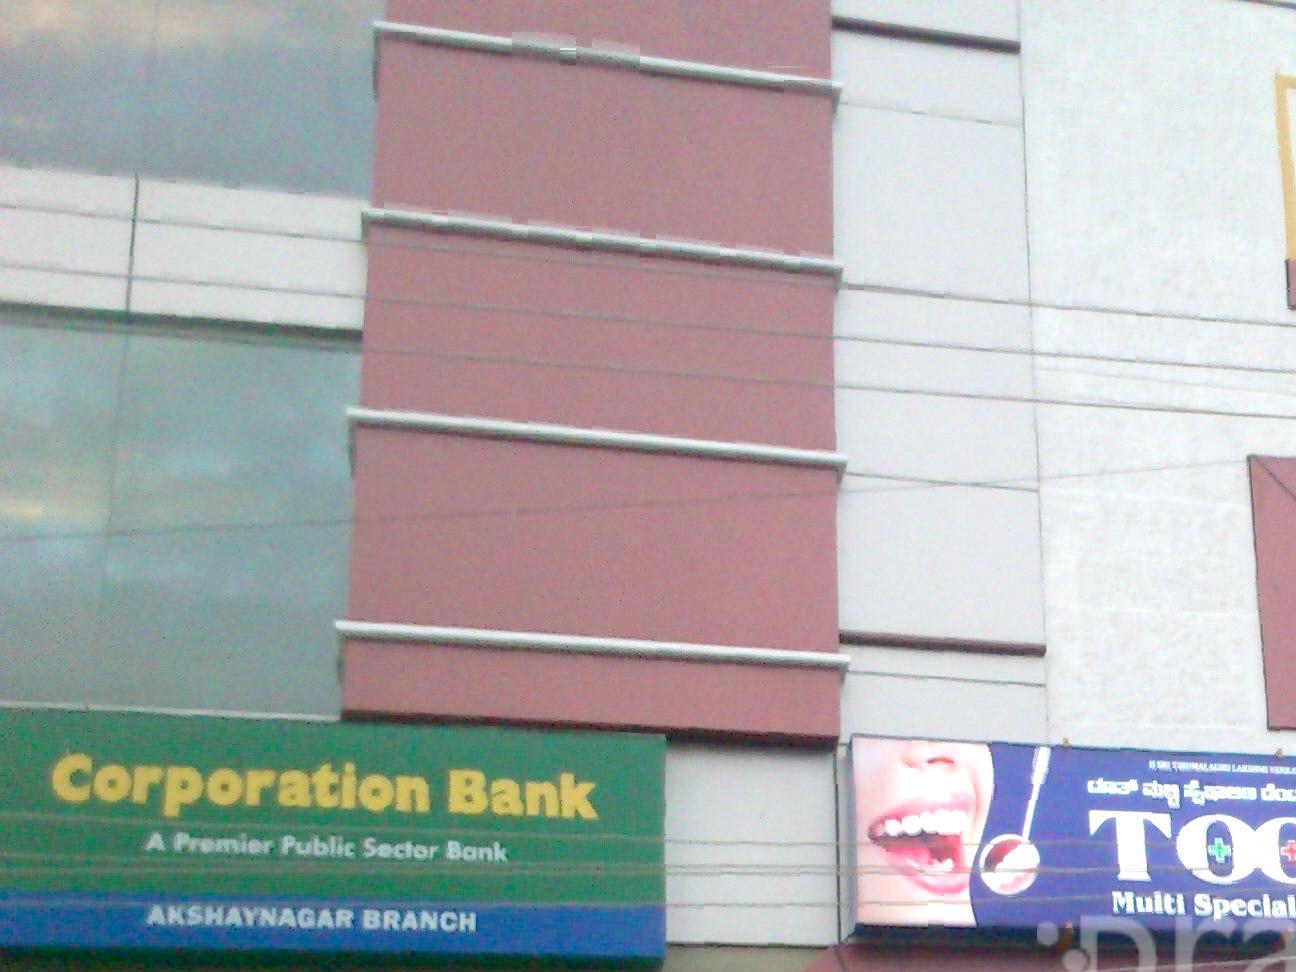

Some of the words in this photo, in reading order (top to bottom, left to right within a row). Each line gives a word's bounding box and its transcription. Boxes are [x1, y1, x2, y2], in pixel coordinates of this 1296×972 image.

[52, 753, 430, 817] Corporation
[448, 769, 598, 820] Bank
[146, 832, 165, 852] A
[174, 832, 273, 855] Premier
[281, 834, 355, 859] Public
[364, 838, 437, 861] Sector
[447, 841, 509, 863] Bank
[1111, 890, 1185, 916] Multi
[146, 904, 352, 929] AKSHAYNAGAR
[363, 907, 476, 932] BRANCH
